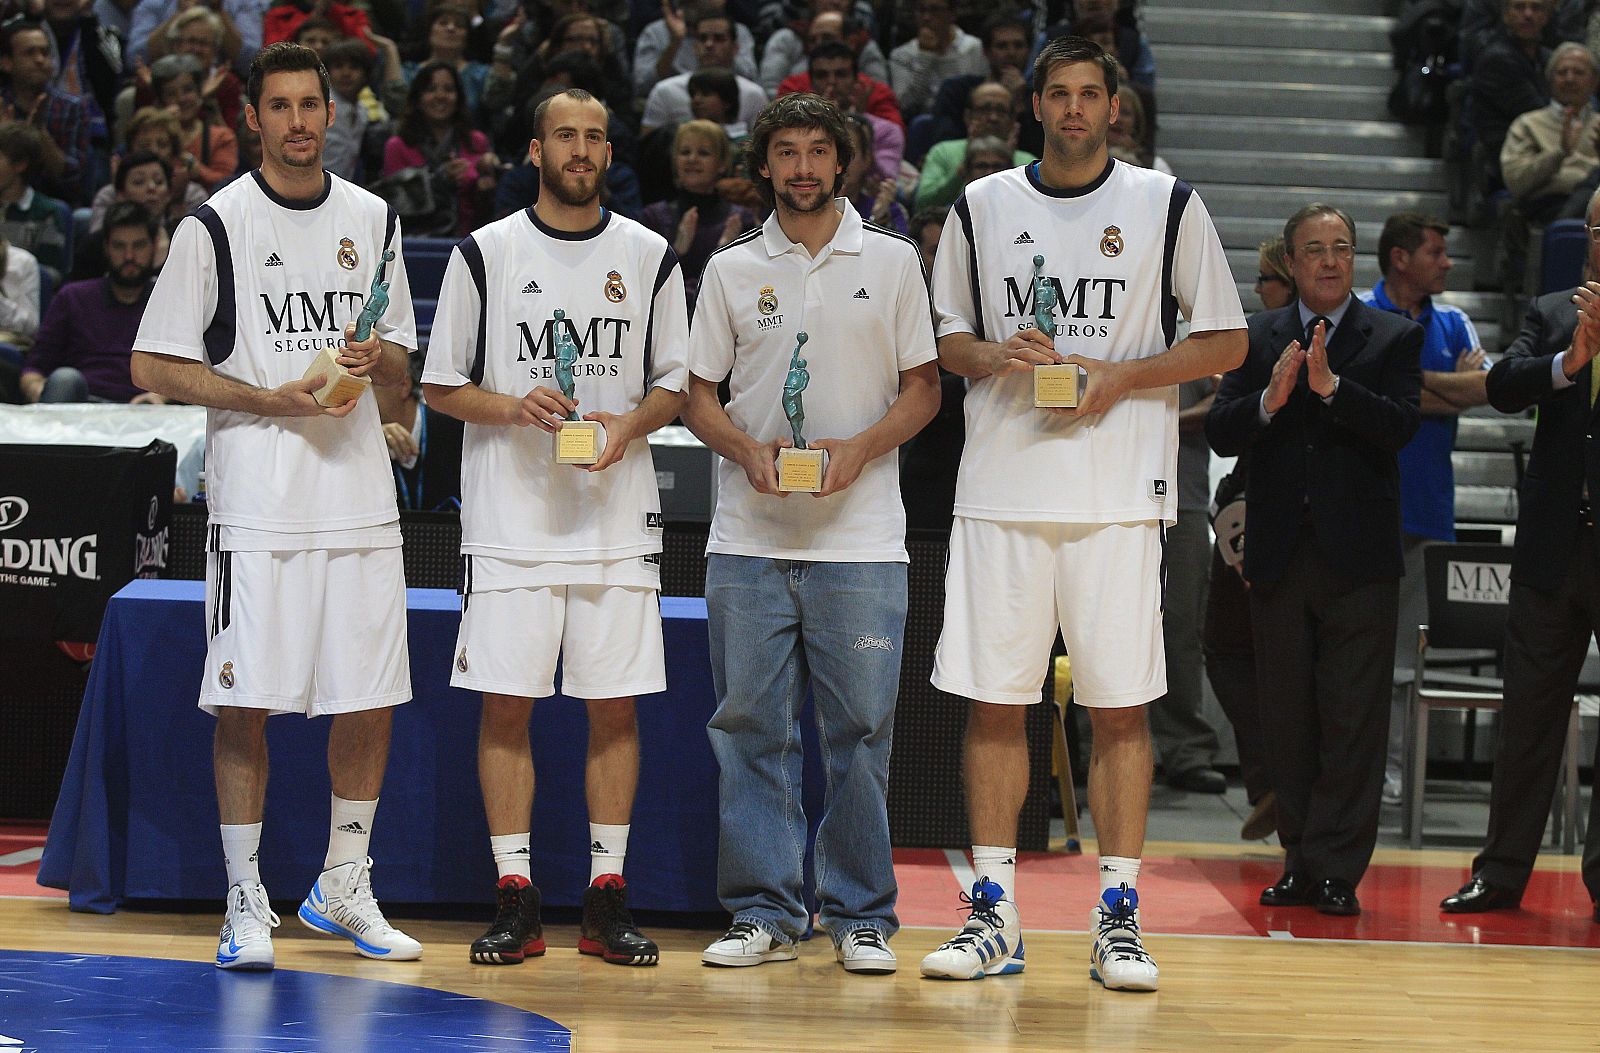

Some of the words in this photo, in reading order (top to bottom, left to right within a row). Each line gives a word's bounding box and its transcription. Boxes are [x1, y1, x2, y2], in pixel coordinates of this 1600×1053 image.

[1004, 276, 1126, 319] MMT
[260, 291, 364, 334] MMT
[757, 314, 784, 328] MMT
[516, 317, 630, 361] MMT
[1017, 322, 1108, 337] SEUROS
[275, 338, 347, 352] SEGURO
[529, 364, 618, 379] SEUROS
[0, 534, 97, 579] DING
[20, 576, 50, 587] GAME
[1451, 564, 1510, 591] MM
